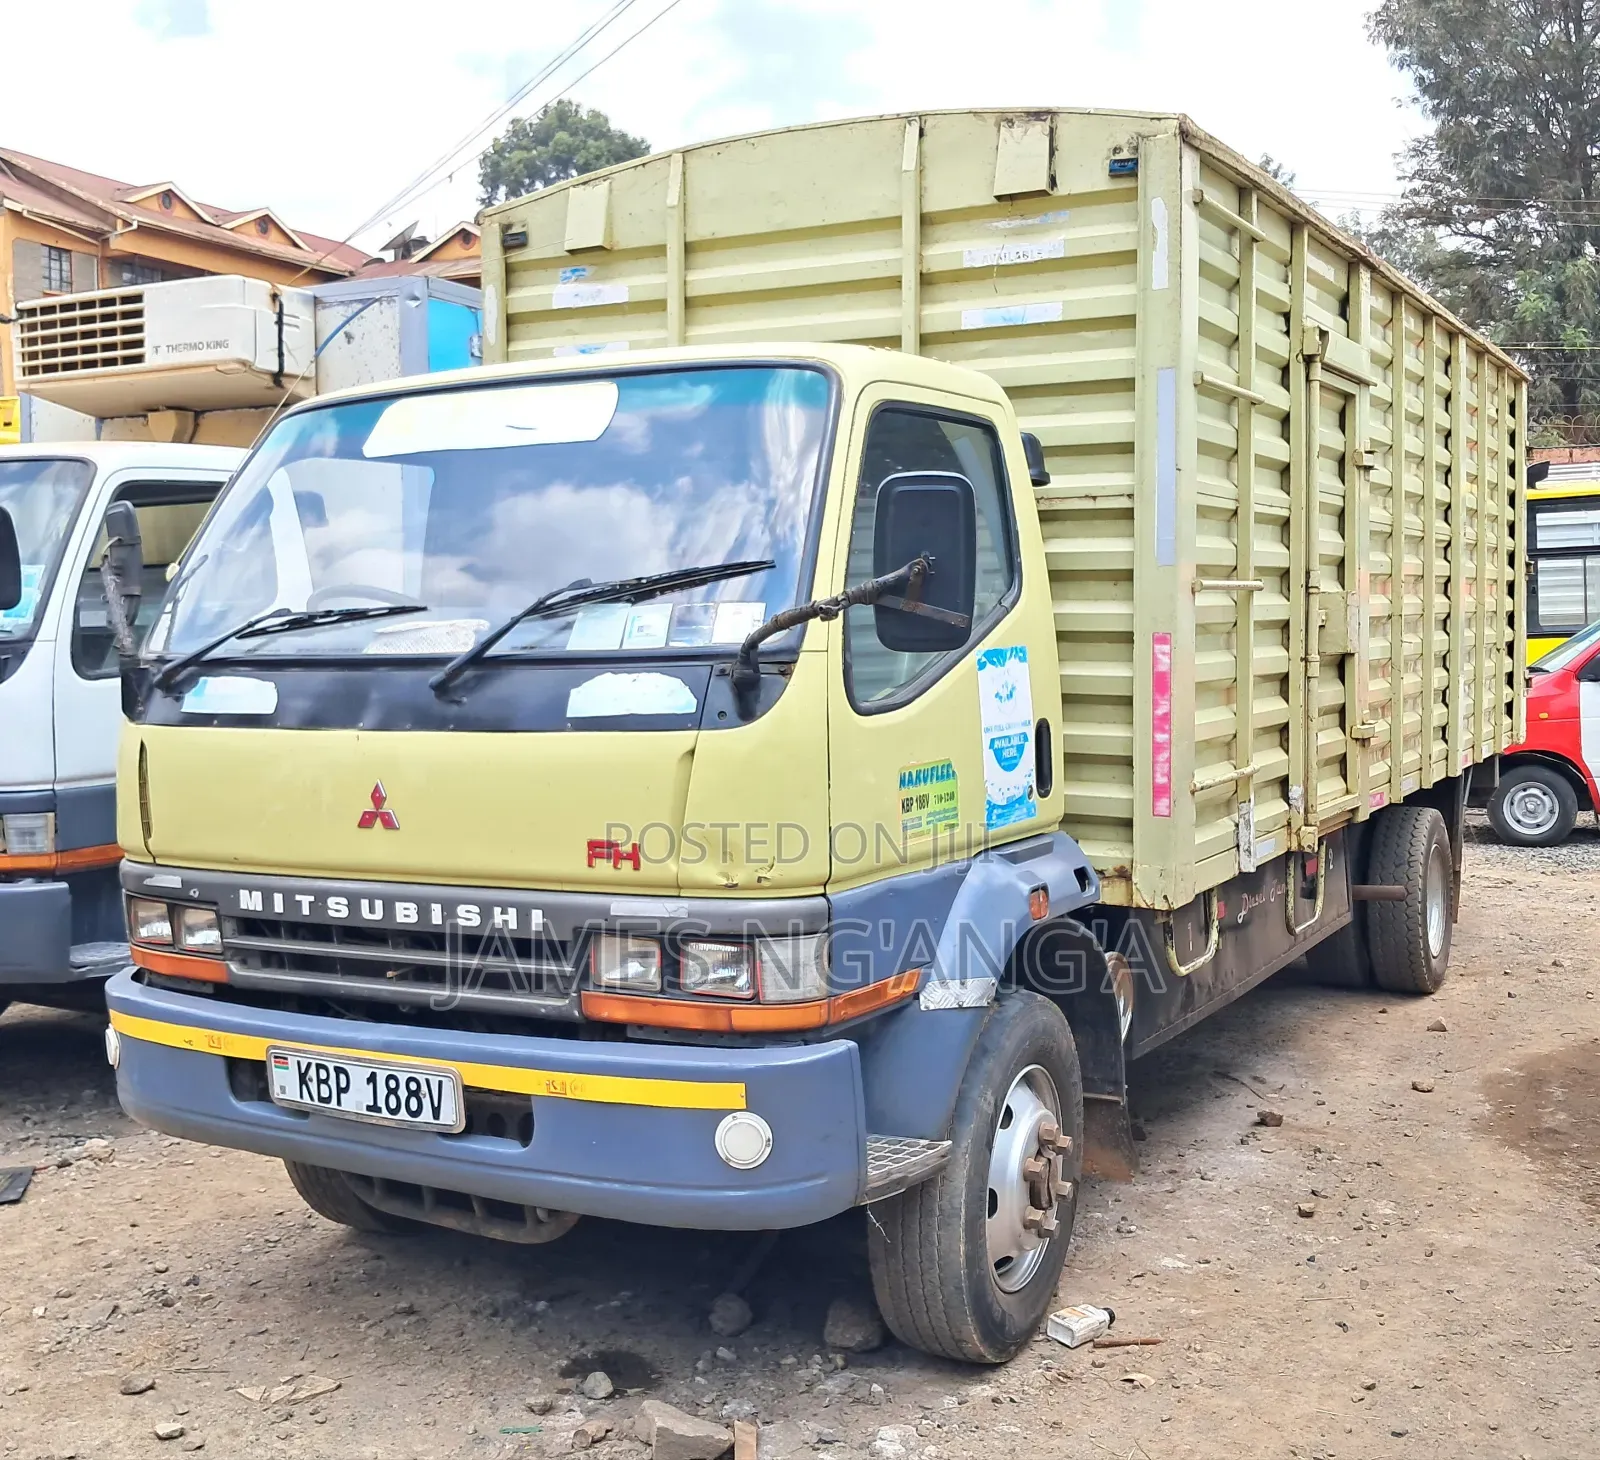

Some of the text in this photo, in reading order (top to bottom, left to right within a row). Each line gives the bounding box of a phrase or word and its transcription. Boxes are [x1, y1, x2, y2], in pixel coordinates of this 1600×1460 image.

[166, 339, 229, 354] THERMO KING
[994, 734, 1025, 750] AVAILABLE
[901, 797, 914, 814] KBP
[587, 839, 641, 870] FH
[239, 889, 544, 931] MITSUBISHI
[297, 1060, 443, 1121] KBP 188V
